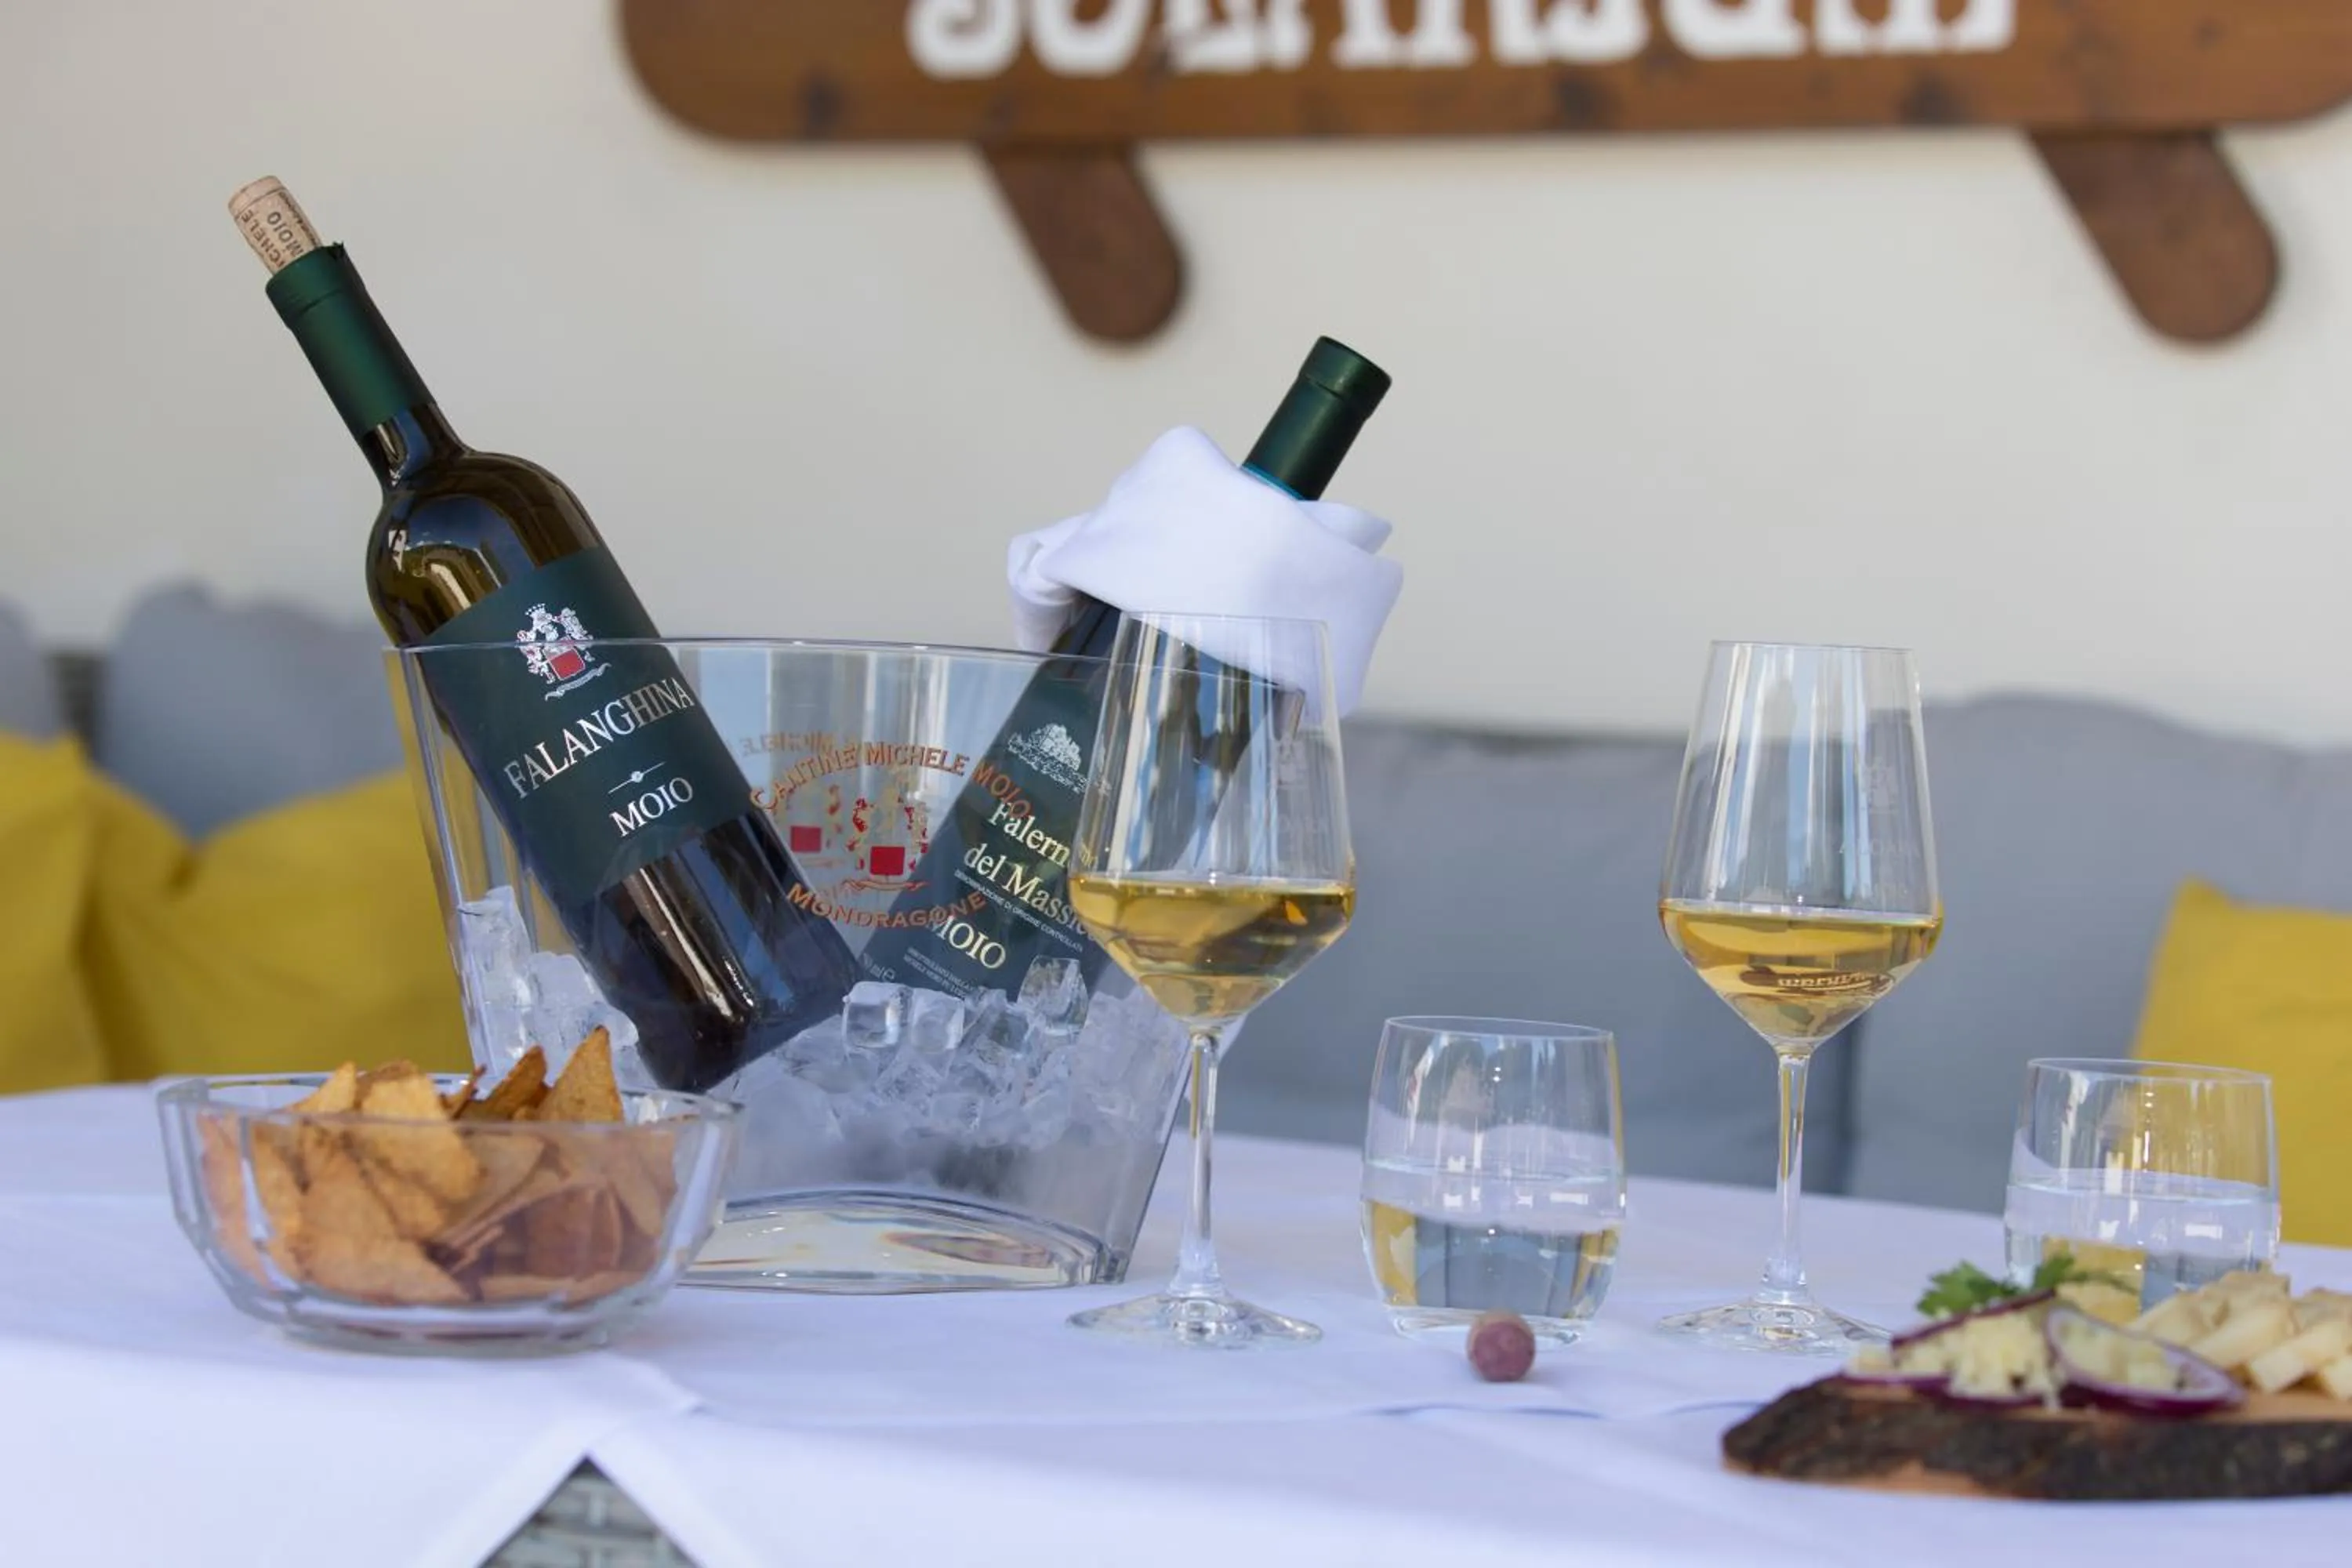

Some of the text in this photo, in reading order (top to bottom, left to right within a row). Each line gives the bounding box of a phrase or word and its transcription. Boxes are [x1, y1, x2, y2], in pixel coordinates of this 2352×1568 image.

[267, 211, 304, 257] MOIO
[503, 676, 695, 800] FALANGHINA
[750, 745, 858, 811] CANTINE
[866, 742, 971, 776] MICHELE
[608, 777, 694, 838] MOIO
[988, 799, 1072, 868] Falern
[964, 843, 1007, 883] del
[786, 882, 988, 928] MONDRAGONE
